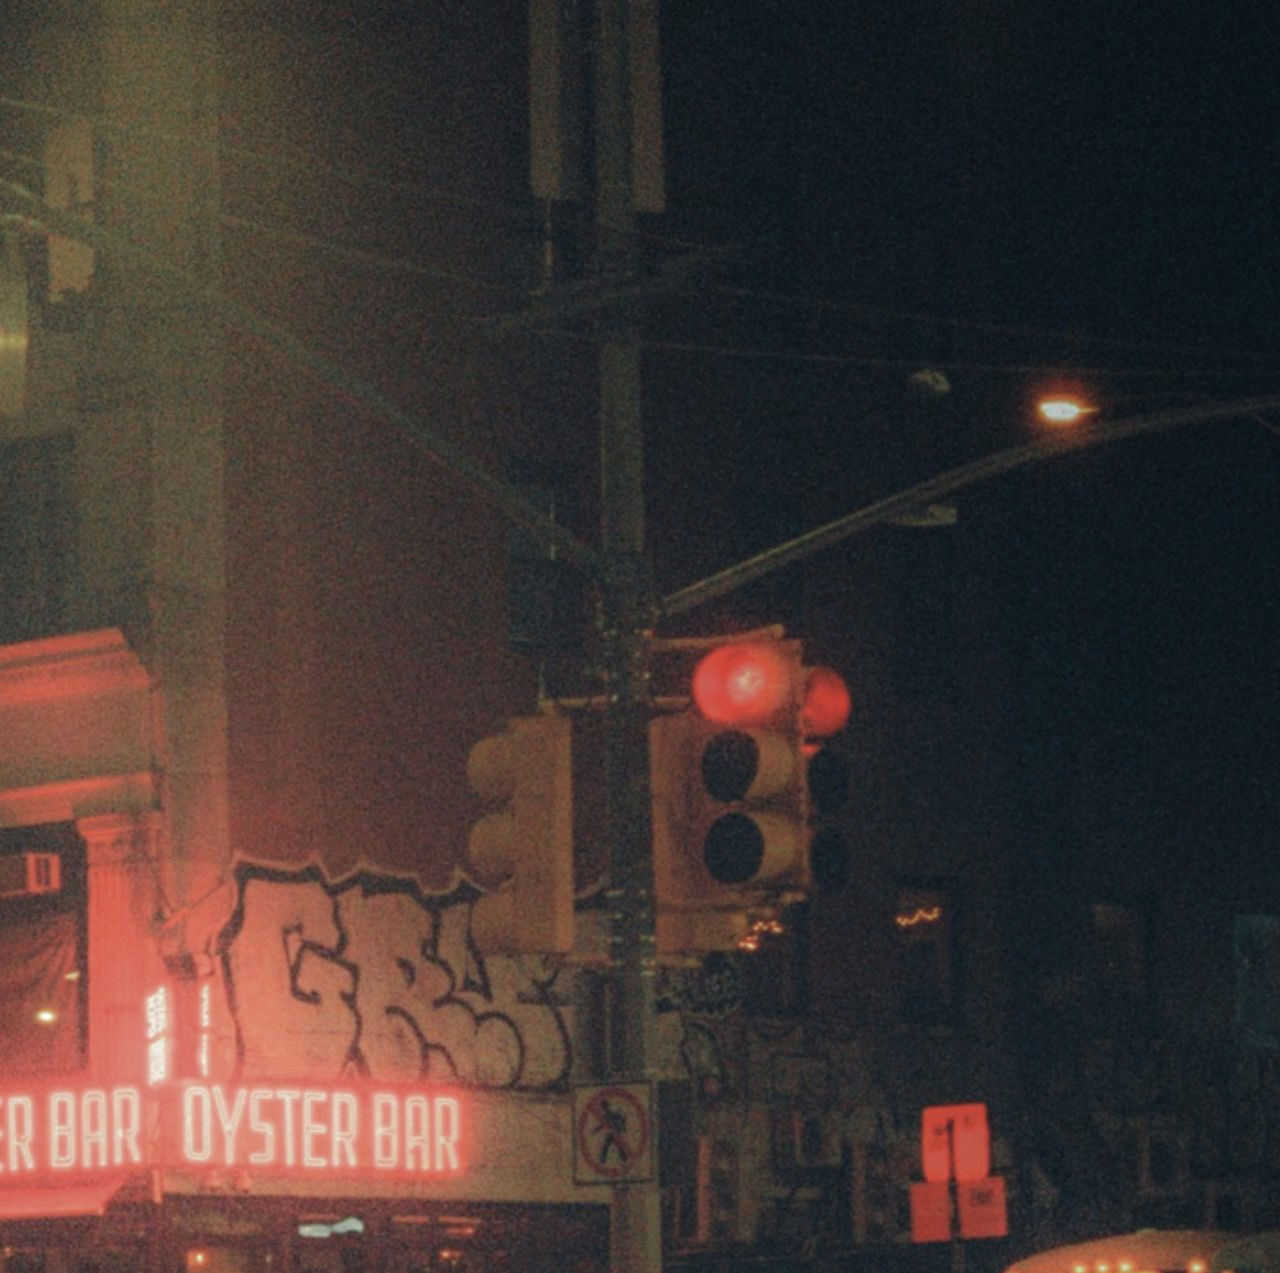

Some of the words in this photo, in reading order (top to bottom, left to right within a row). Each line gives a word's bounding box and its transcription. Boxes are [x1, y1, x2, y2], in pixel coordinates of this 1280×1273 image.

[49, 1088, 141, 1169] BAR
[182, 1086, 358, 1168] OYSTER
[372, 1093, 460, 1171] BAR
